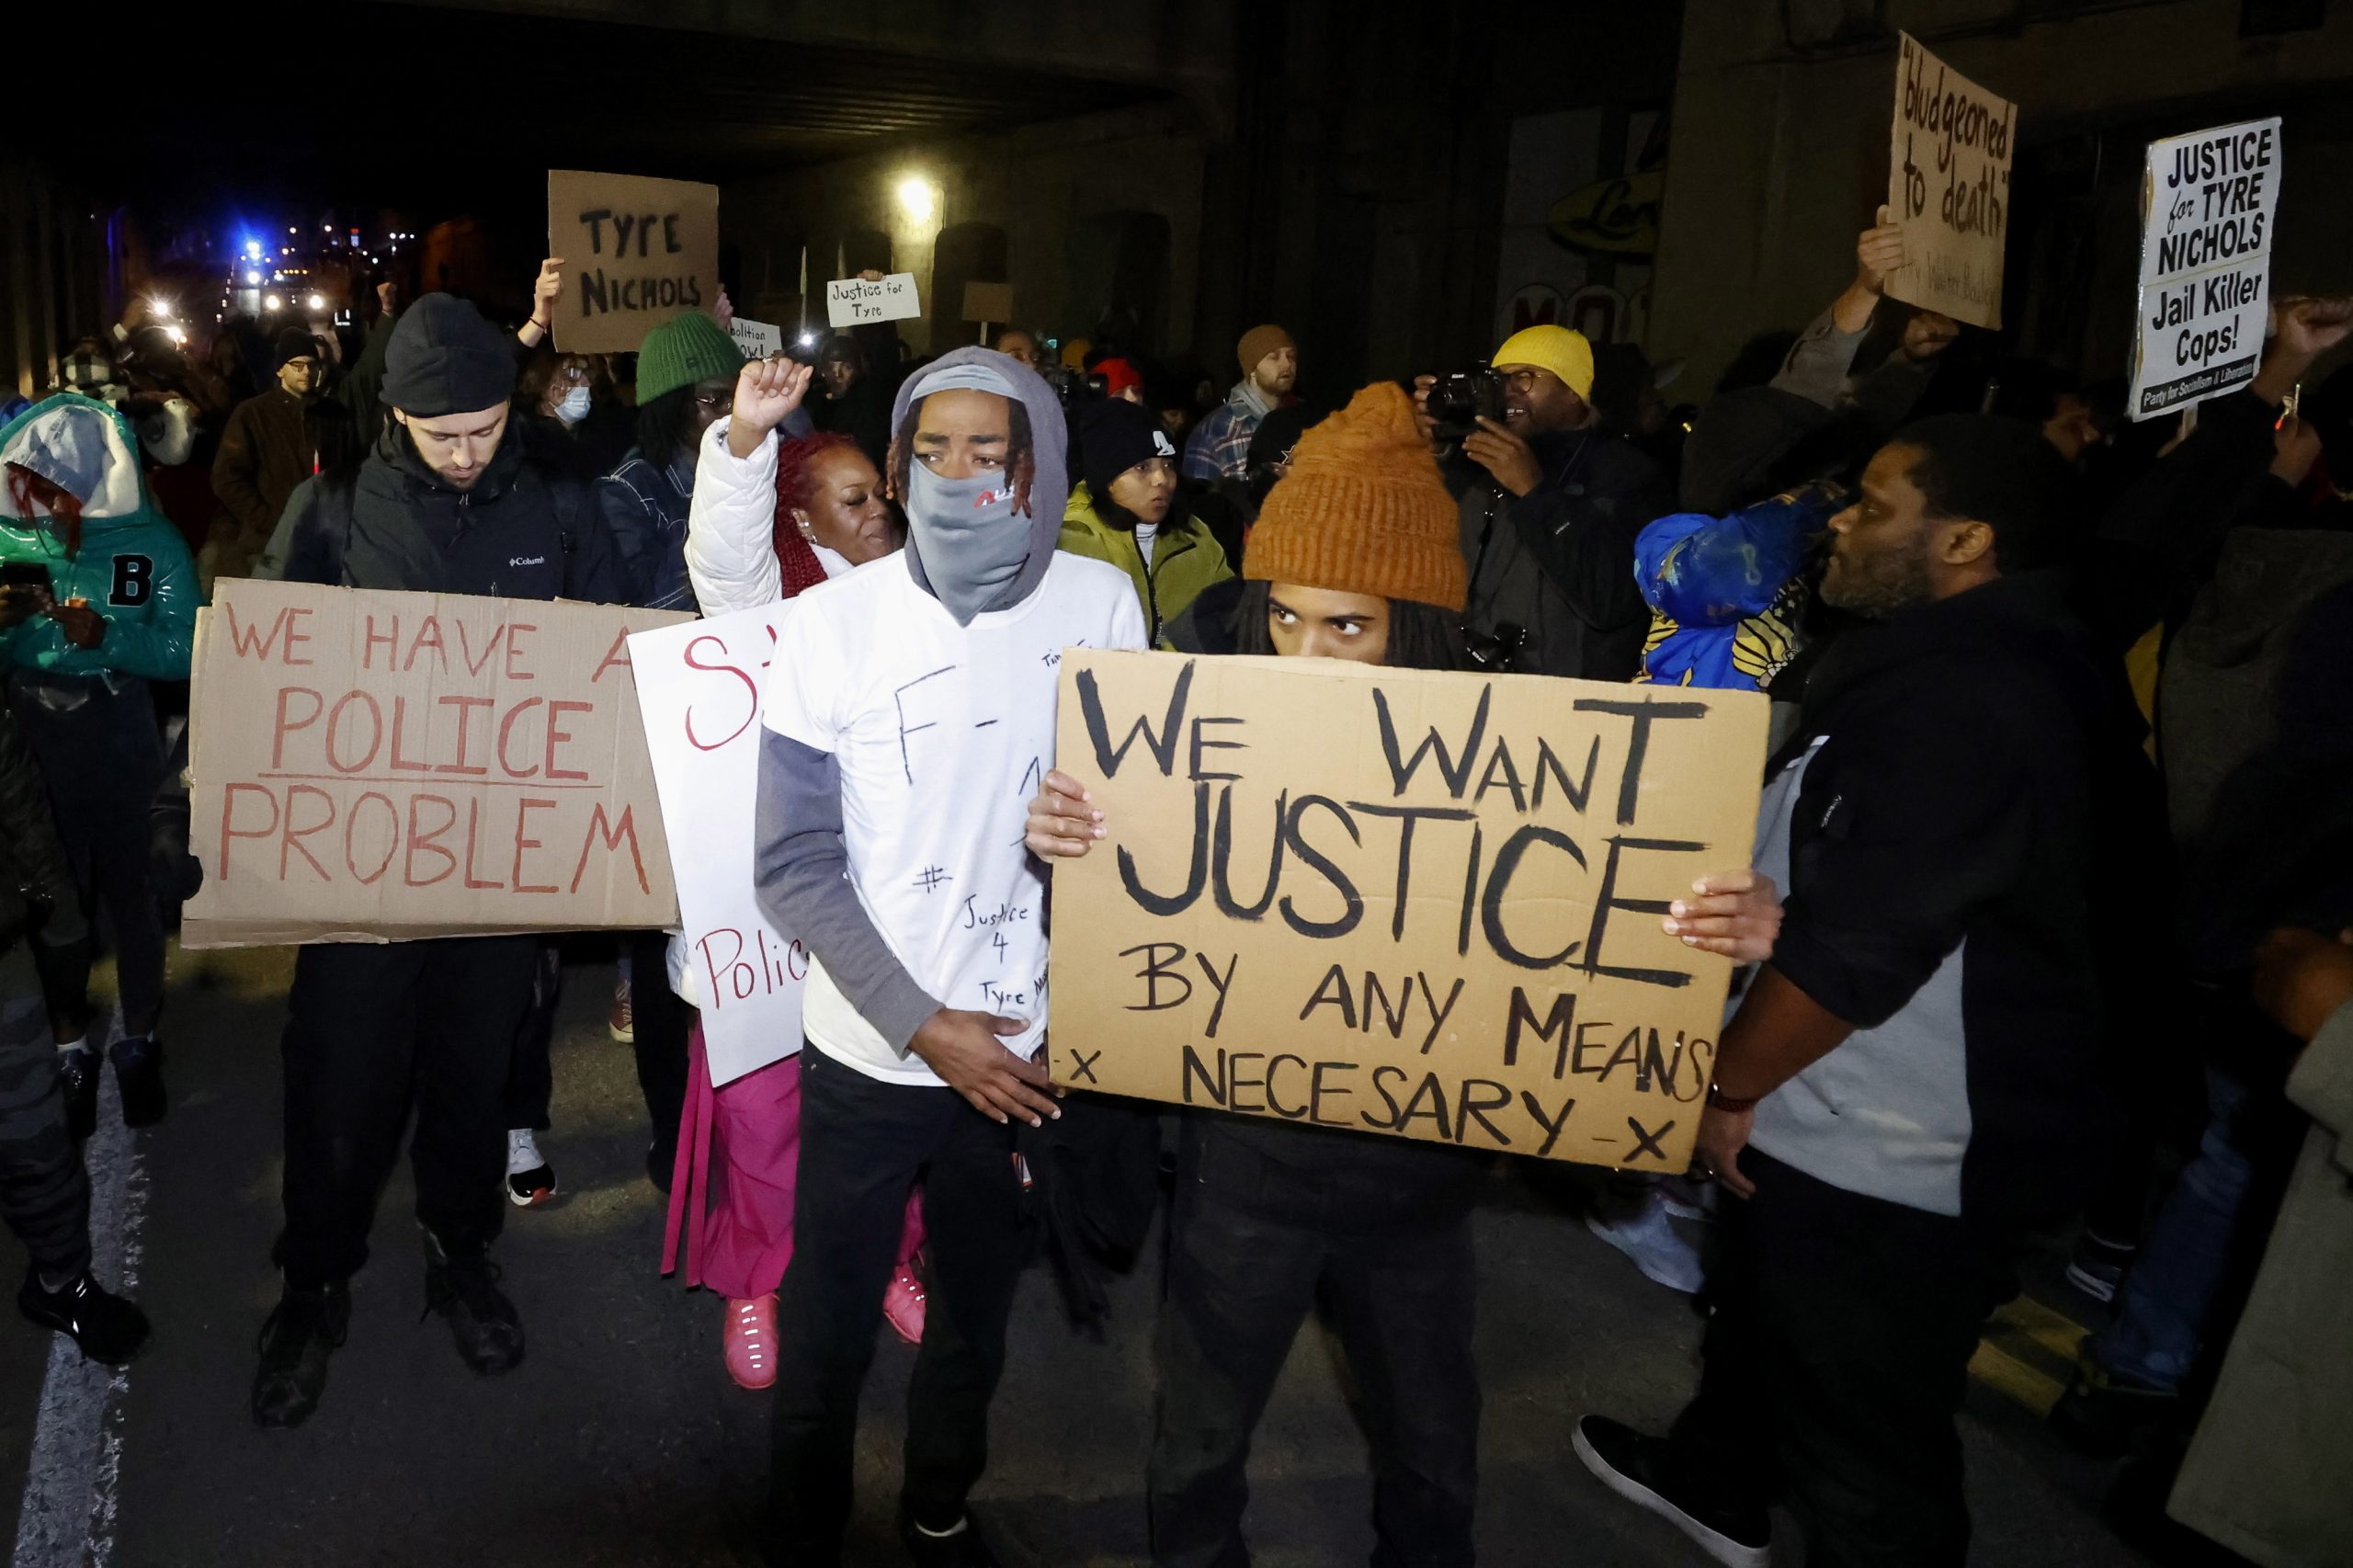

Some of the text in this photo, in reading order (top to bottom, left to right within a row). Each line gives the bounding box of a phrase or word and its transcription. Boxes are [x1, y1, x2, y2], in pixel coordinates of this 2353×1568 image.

[1904, 132, 1926, 221] to
[2167, 128, 2272, 188] JUSTICE
[2168, 172, 2265, 233] for TYRE
[2157, 211, 2265, 276] NICHOLS
[581, 268, 701, 317] NICHOLS
[833, 281, 902, 301] Justice for
[852, 302, 881, 317] Tyre
[2152, 271, 2262, 331] Jail Killer
[2176, 314, 2240, 367] Cops!
[2143, 391, 2167, 406] Party
[108, 553, 154, 608] B
[226, 601, 632, 683] WE HAVE A
[272, 687, 594, 780] POLICE
[1074, 658, 1711, 825] WE WANT
[220, 782, 650, 895] PROBLEM
[964, 893, 1029, 929] Justice
[1117, 778, 1711, 988] JUSTICE
[696, 928, 810, 1010] Polic
[993, 931, 1009, 965] 4
[1118, 942, 1238, 1038] BY
[1299, 963, 1466, 1055] ANY
[1504, 986, 1713, 1103] MEANS
[1182, 1045, 1576, 1156] NECESARY
